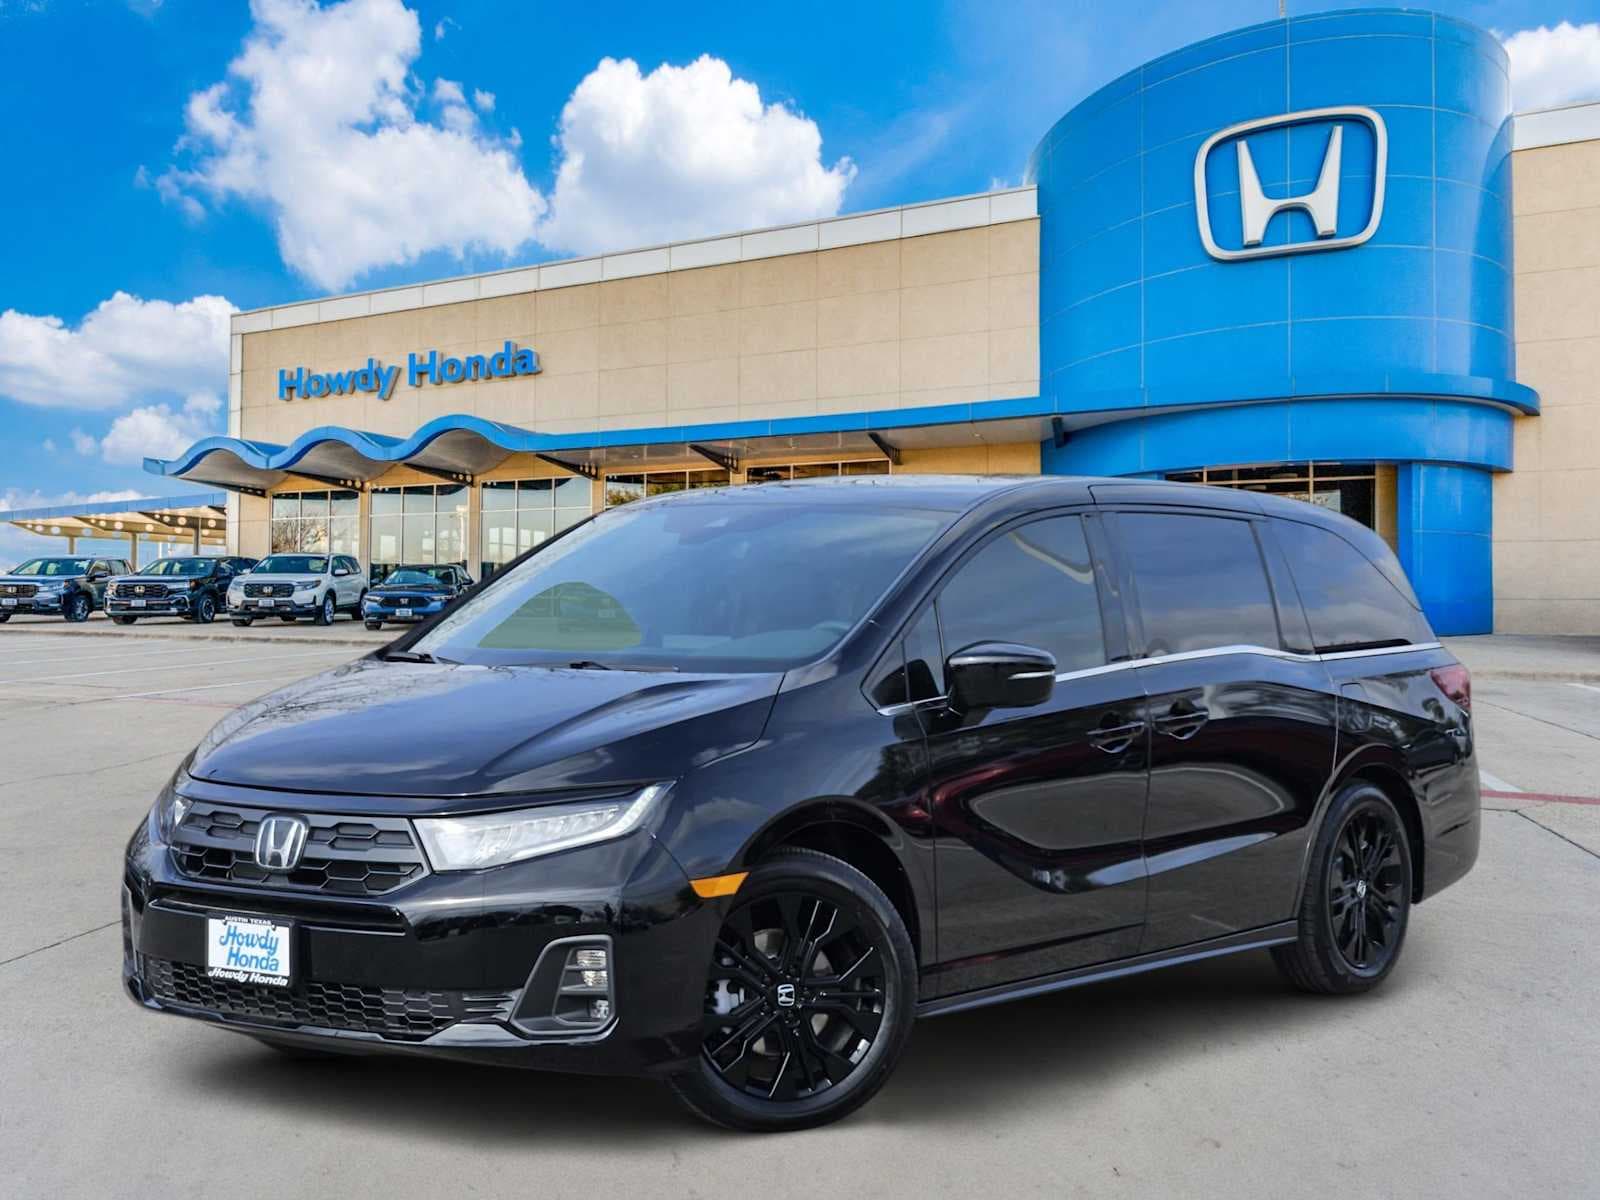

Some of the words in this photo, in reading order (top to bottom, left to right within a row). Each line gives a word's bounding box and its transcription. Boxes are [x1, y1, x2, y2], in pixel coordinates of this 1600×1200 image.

[278, 357, 400, 401] Howdy
[407, 340, 541, 388] Honda
[224, 915, 249, 923] AUSTIN
[219, 924, 279, 956] Howdy
[226, 946, 279, 972] Honda
[207, 967, 249, 983] Howdy
[249, 972, 289, 986] Honda
